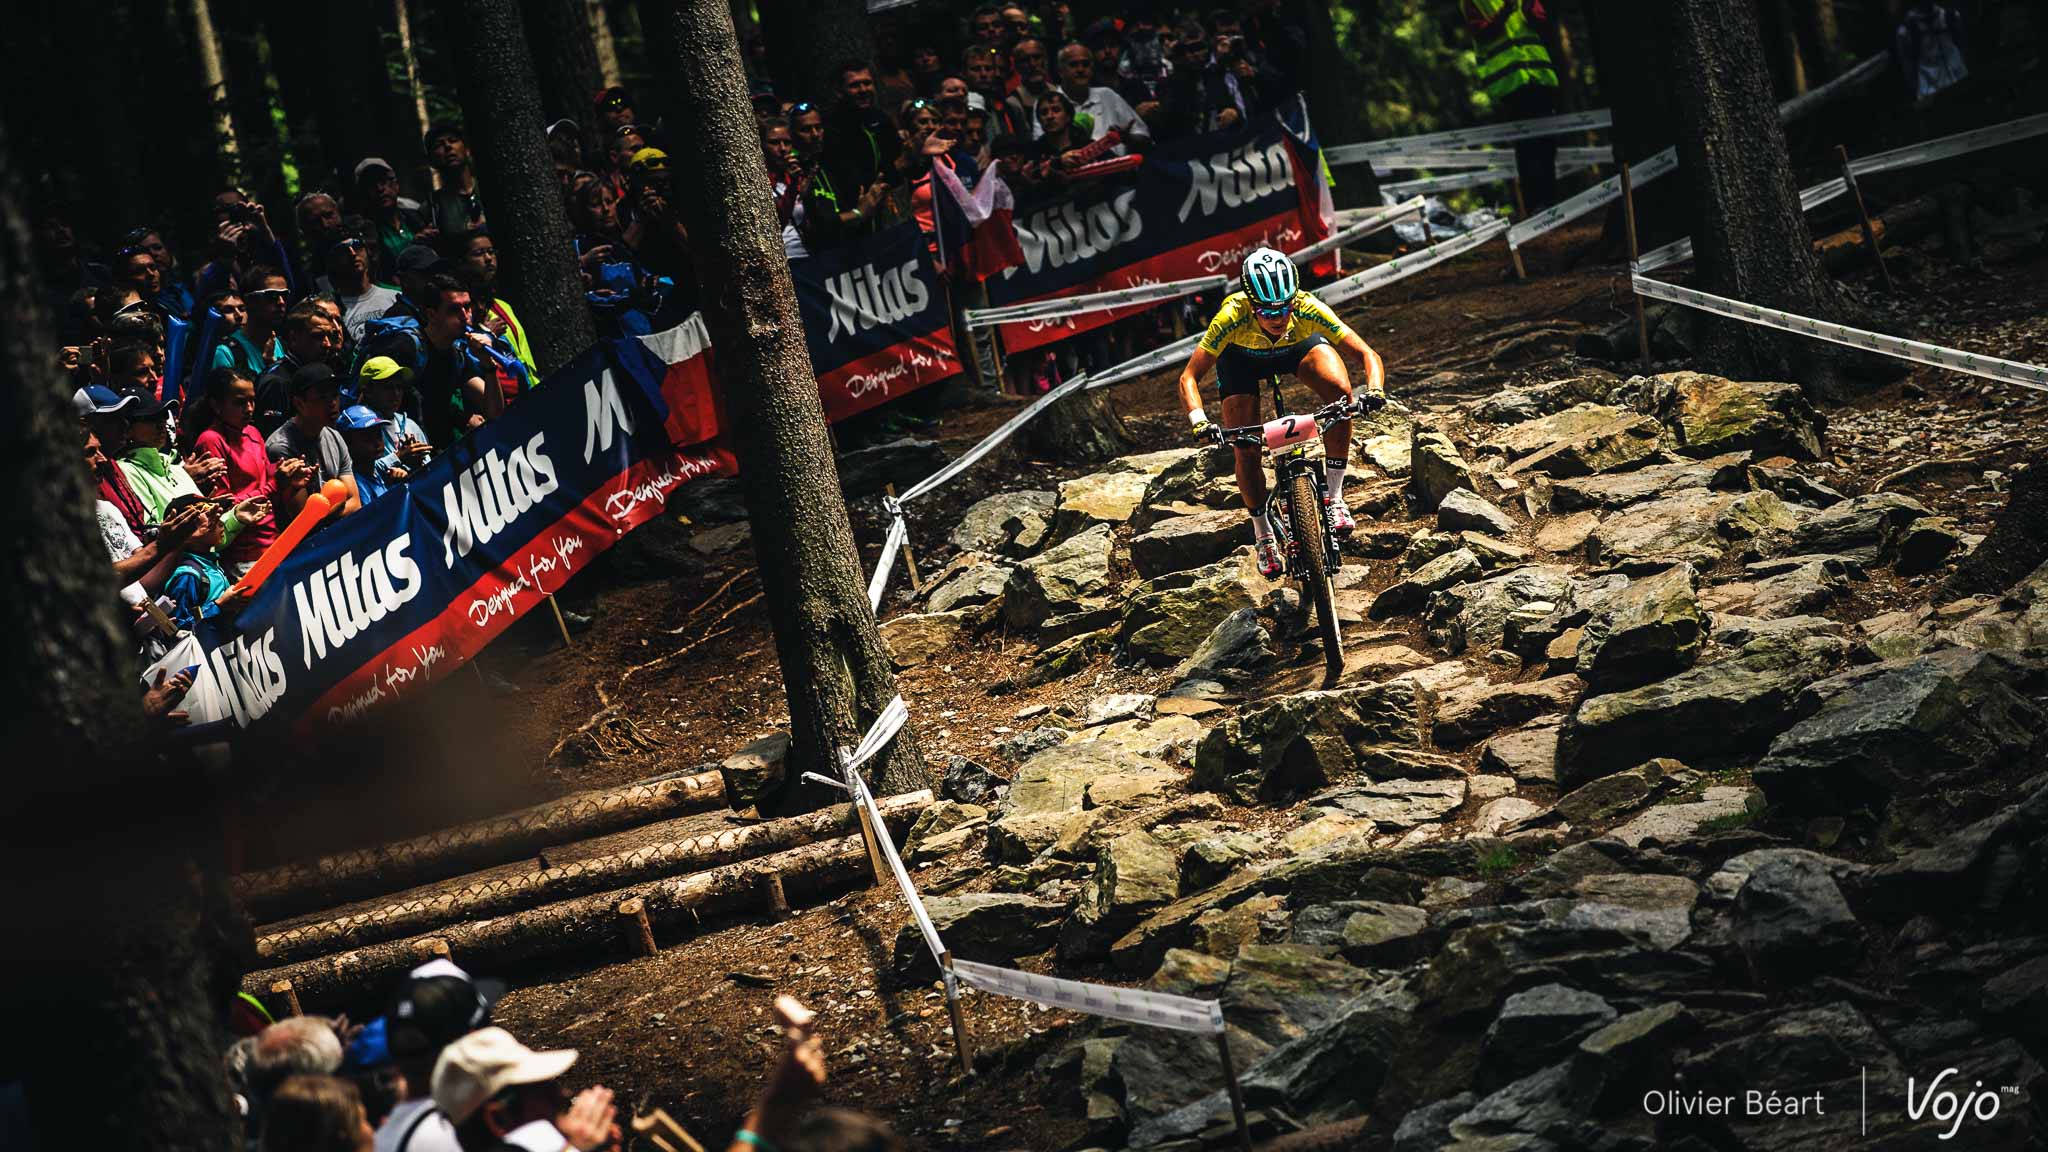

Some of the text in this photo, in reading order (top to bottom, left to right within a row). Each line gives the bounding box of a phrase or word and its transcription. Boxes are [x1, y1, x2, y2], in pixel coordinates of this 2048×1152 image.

[1178, 136, 1296, 223] Mita
[825, 258, 929, 344] Mitas
[845, 353, 908, 398] Designed
[909, 348, 932, 383] for
[1281, 418, 1300, 439] 2
[443, 431, 559, 570] Mitas
[605, 460, 682, 521] Designed
[1282, 513, 1291, 528] DT
[1329, 534, 1340, 551] DT
[293, 532, 422, 671] Mitas
[468, 535, 583, 627] Designed for You
[386, 663, 417, 697] for
[412, 644, 446, 681] You
